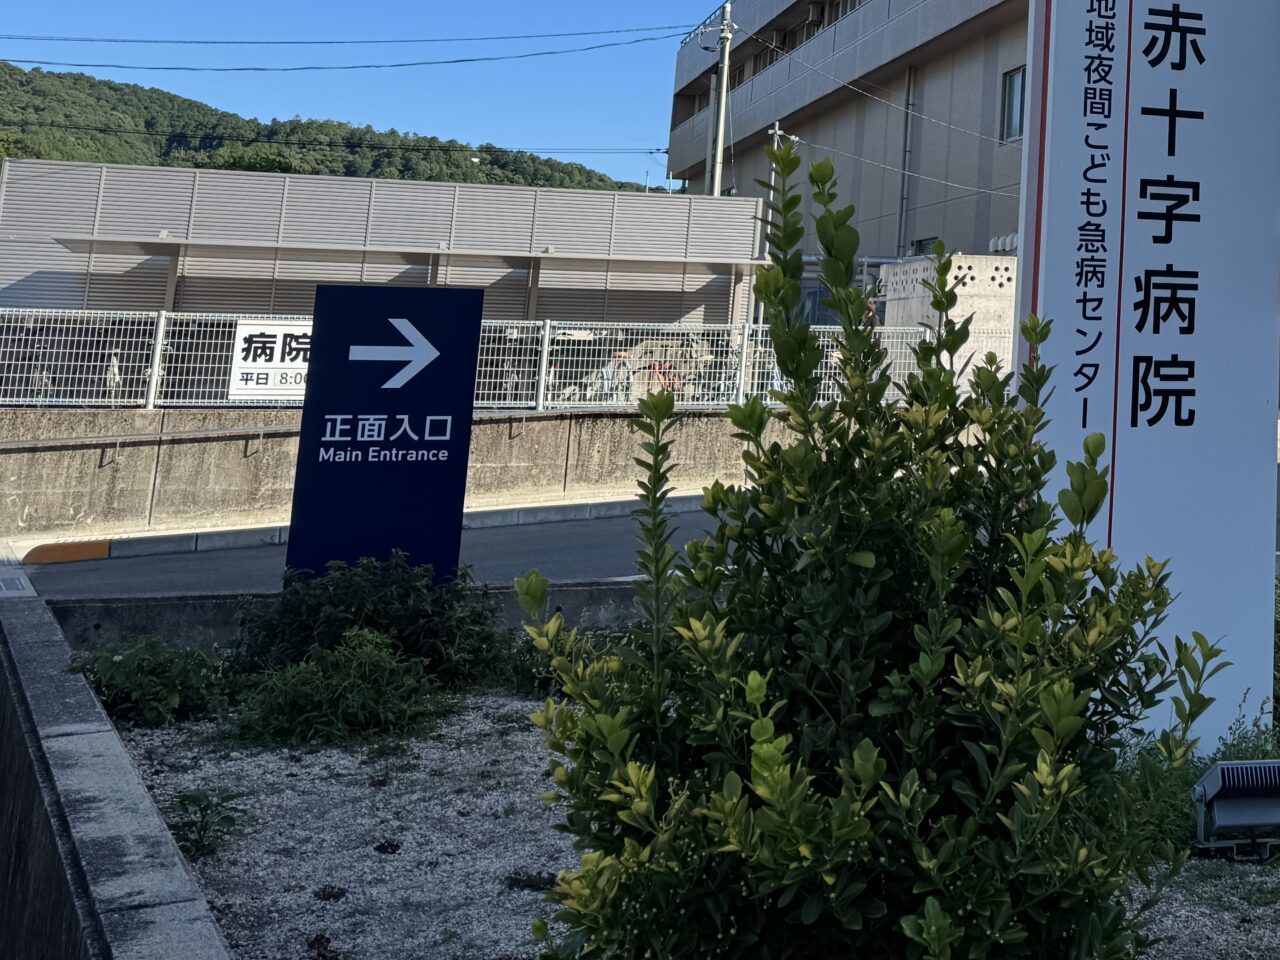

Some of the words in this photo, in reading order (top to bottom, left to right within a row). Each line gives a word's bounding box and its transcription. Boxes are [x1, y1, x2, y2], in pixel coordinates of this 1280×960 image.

[239, 372, 269, 386] 平日
[321, 414, 452, 441] 正面入口
[319, 447, 362, 462] Main
[368, 446, 449, 462] Entrance
